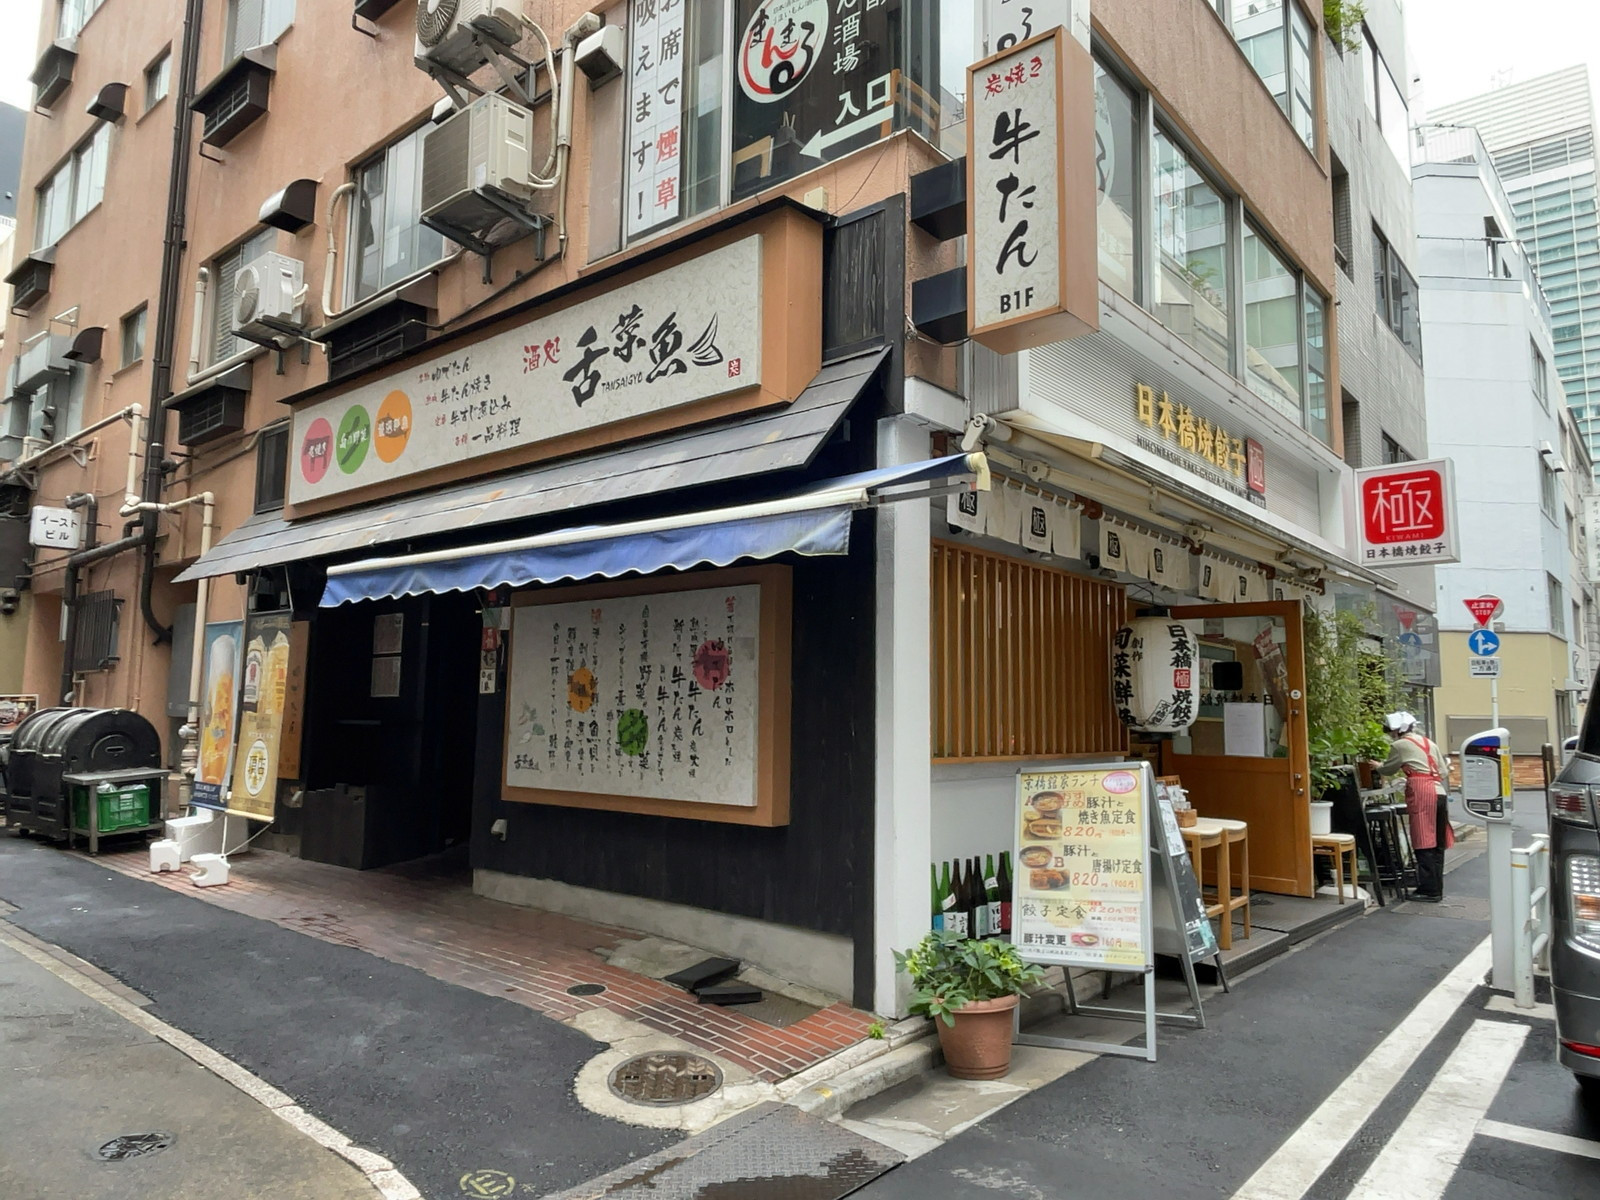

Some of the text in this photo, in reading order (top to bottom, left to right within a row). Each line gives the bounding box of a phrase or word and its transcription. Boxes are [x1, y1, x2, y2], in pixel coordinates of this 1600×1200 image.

[985, 56, 1043, 100] 炭焼き
[835, 73, 892, 125] 入口
[989, 108, 1040, 275] 牛たん
[1000, 287, 1034, 314] B1F
[523, 336, 561, 374] 酒処
[440, 373, 491, 405] 牛たん焼き
[602, 371, 643, 393] TANSAIGYO
[450, 394, 512, 426] 牛すじ煮込み
[472, 417, 521, 443] 一品料理
[1136, 382, 1246, 478] 日本橋焼餃子
[1371, 477, 1433, 533] 極
[40, 515, 78, 530] イースト
[45, 529, 69, 541] ビル
[1386, 533, 1424, 541] KIWAMI
[1366, 543, 1446, 559] 日本橋焼餃子
[1471, 601, 1494, 609] 止まれ
[1130, 637, 1143, 662] 創作
[1086, 796, 1124, 808] 豚汁と
[1078, 809, 1136, 825] 焼き魚定食
[1063, 844, 1098, 857] 豚汁と
[1054, 857, 1064, 867] B
[1092, 859, 1142, 874] 唐揚げ定食
[1022, 904, 1087, 920] 餃子定食
[1023, 933, 1067, 947] 豚汁変更
